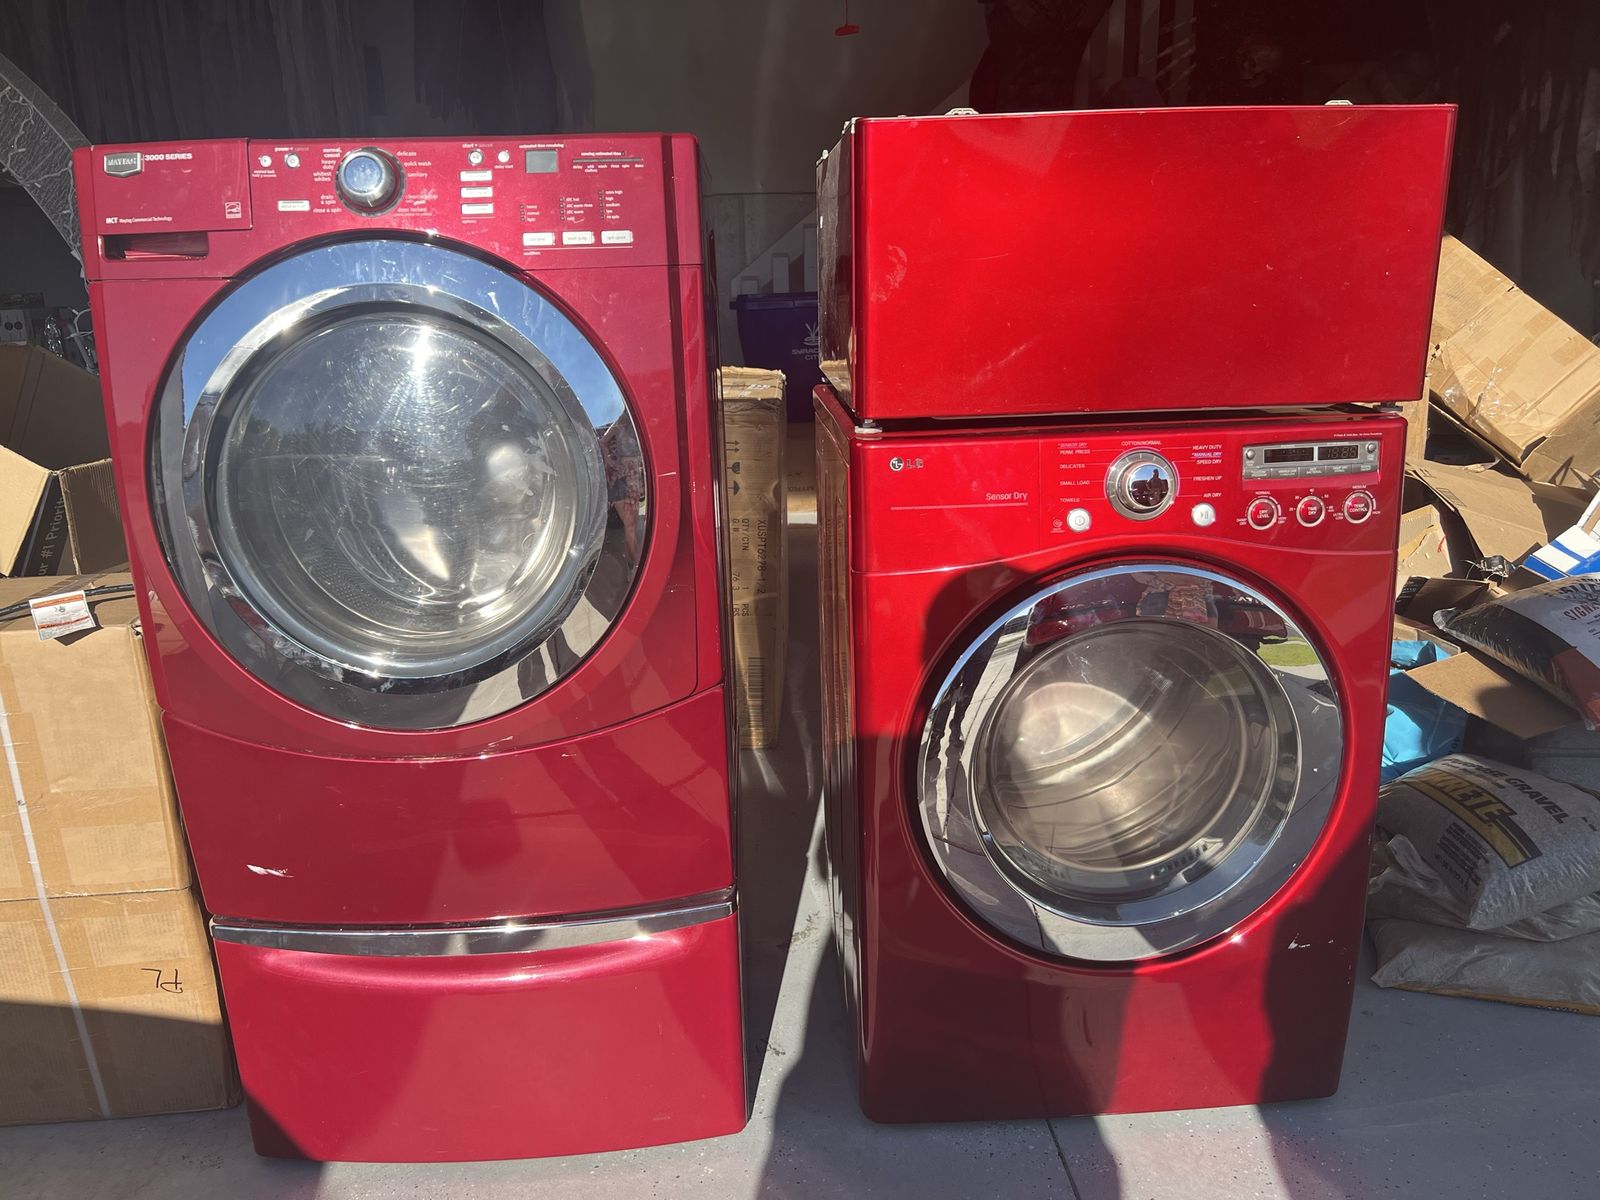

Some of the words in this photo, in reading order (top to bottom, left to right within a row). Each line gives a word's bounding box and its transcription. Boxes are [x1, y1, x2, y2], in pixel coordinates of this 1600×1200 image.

[144, 153, 164, 161] 3000
[165, 152, 193, 161] SERIES
[906, 458, 924, 469] LG
[985, 492, 1012, 501] Sensor
[1013, 491, 1028, 500] Dry
[1505, 777, 1570, 825] GRAVEL
